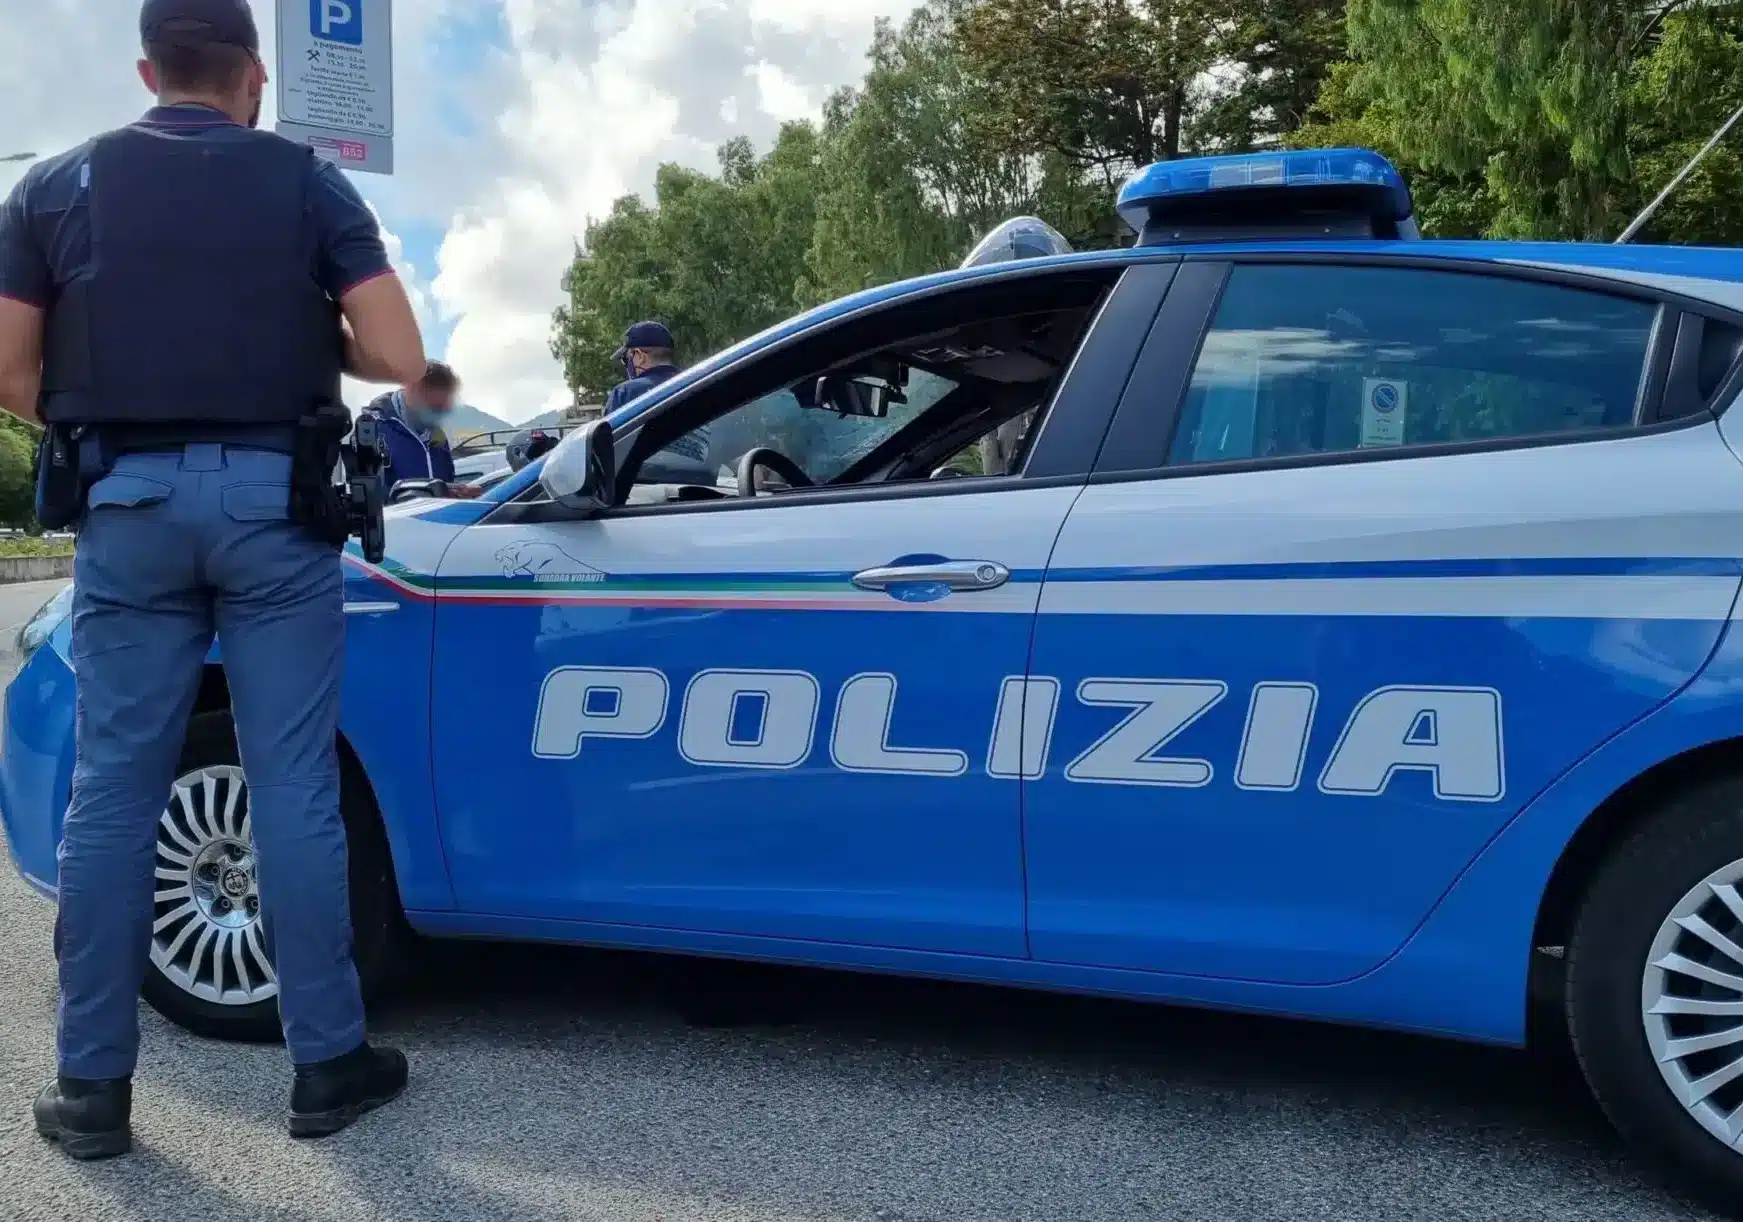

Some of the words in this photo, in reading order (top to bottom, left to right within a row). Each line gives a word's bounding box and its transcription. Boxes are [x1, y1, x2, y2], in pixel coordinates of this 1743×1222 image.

[320, 0, 352, 34] P
[570, 573, 606, 583] VOLANTE
[530, 664, 1506, 802] POLIZIA
